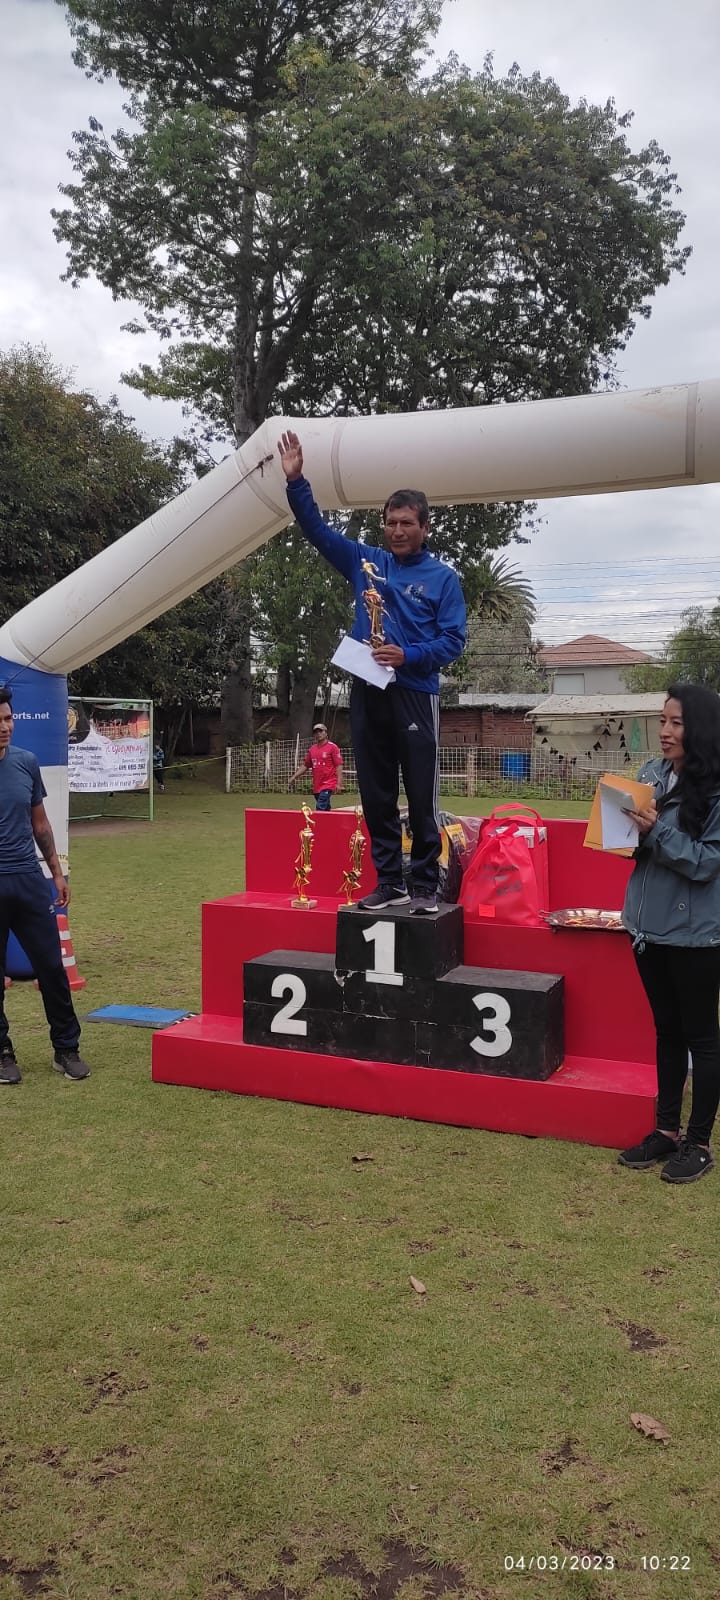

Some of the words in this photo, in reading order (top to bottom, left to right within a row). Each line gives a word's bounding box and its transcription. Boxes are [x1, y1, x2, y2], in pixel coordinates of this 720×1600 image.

[362, 920, 404, 986] 1
[270, 973, 307, 1036] 2
[469, 992, 513, 1057] 3
